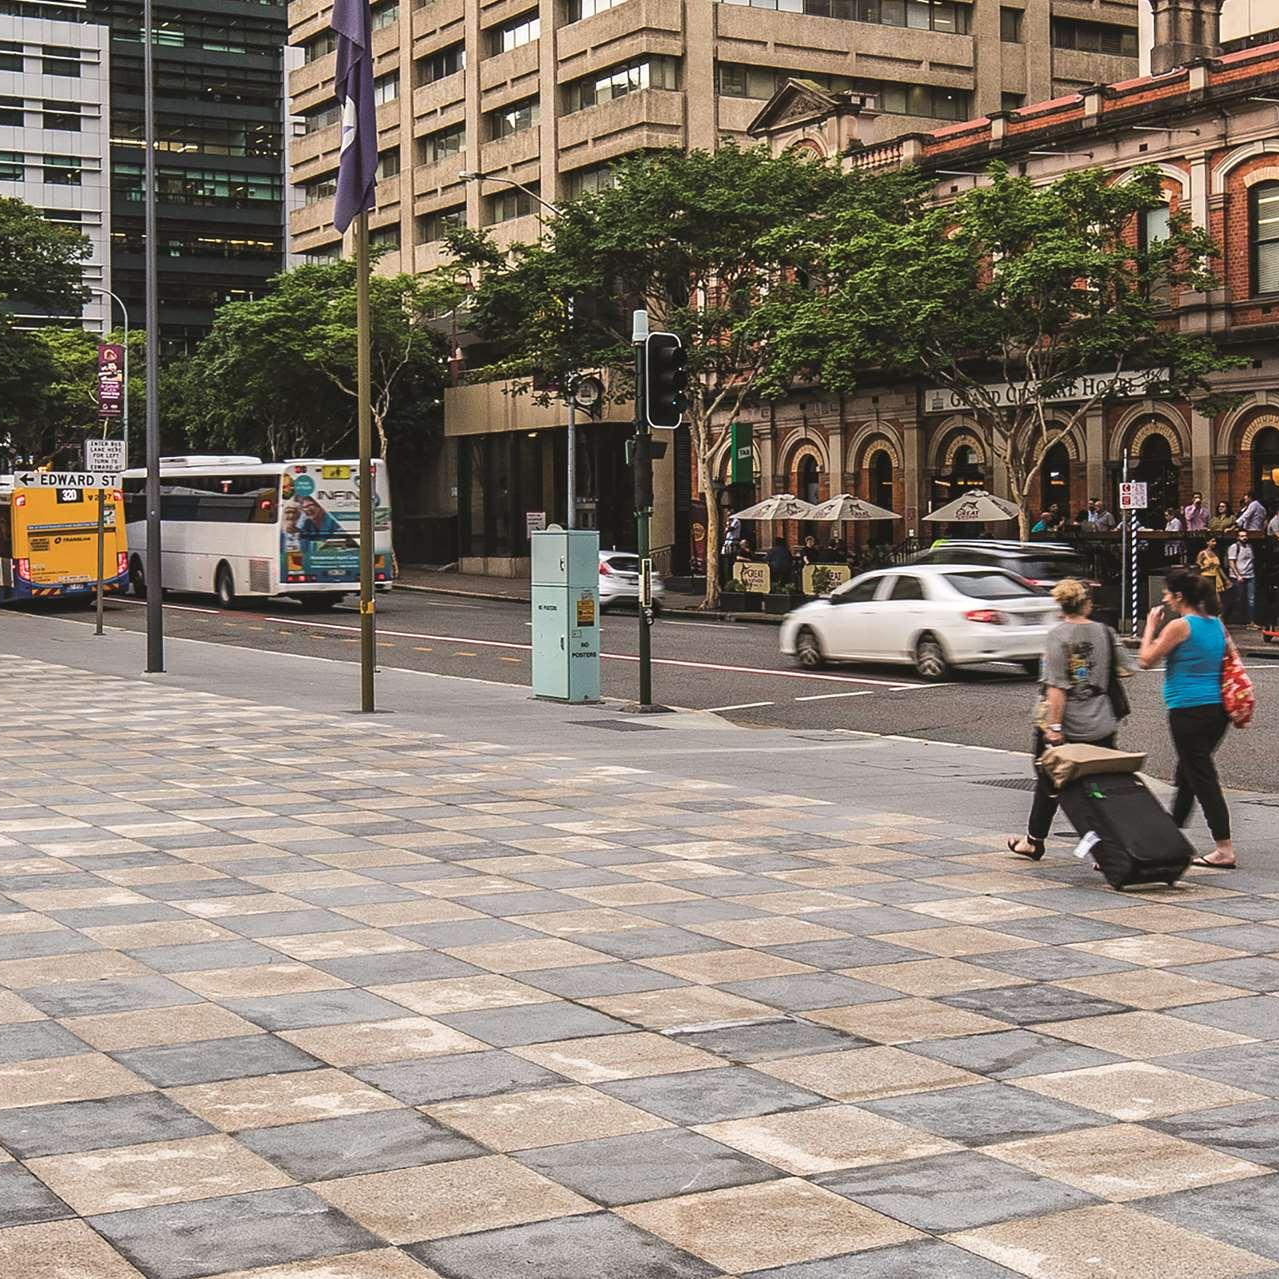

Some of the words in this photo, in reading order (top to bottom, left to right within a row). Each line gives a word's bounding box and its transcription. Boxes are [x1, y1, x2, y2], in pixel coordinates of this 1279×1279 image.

[41, 475, 94, 486] EDWARD
[102, 475, 116, 486] ST
[62, 490, 77, 501] 320
